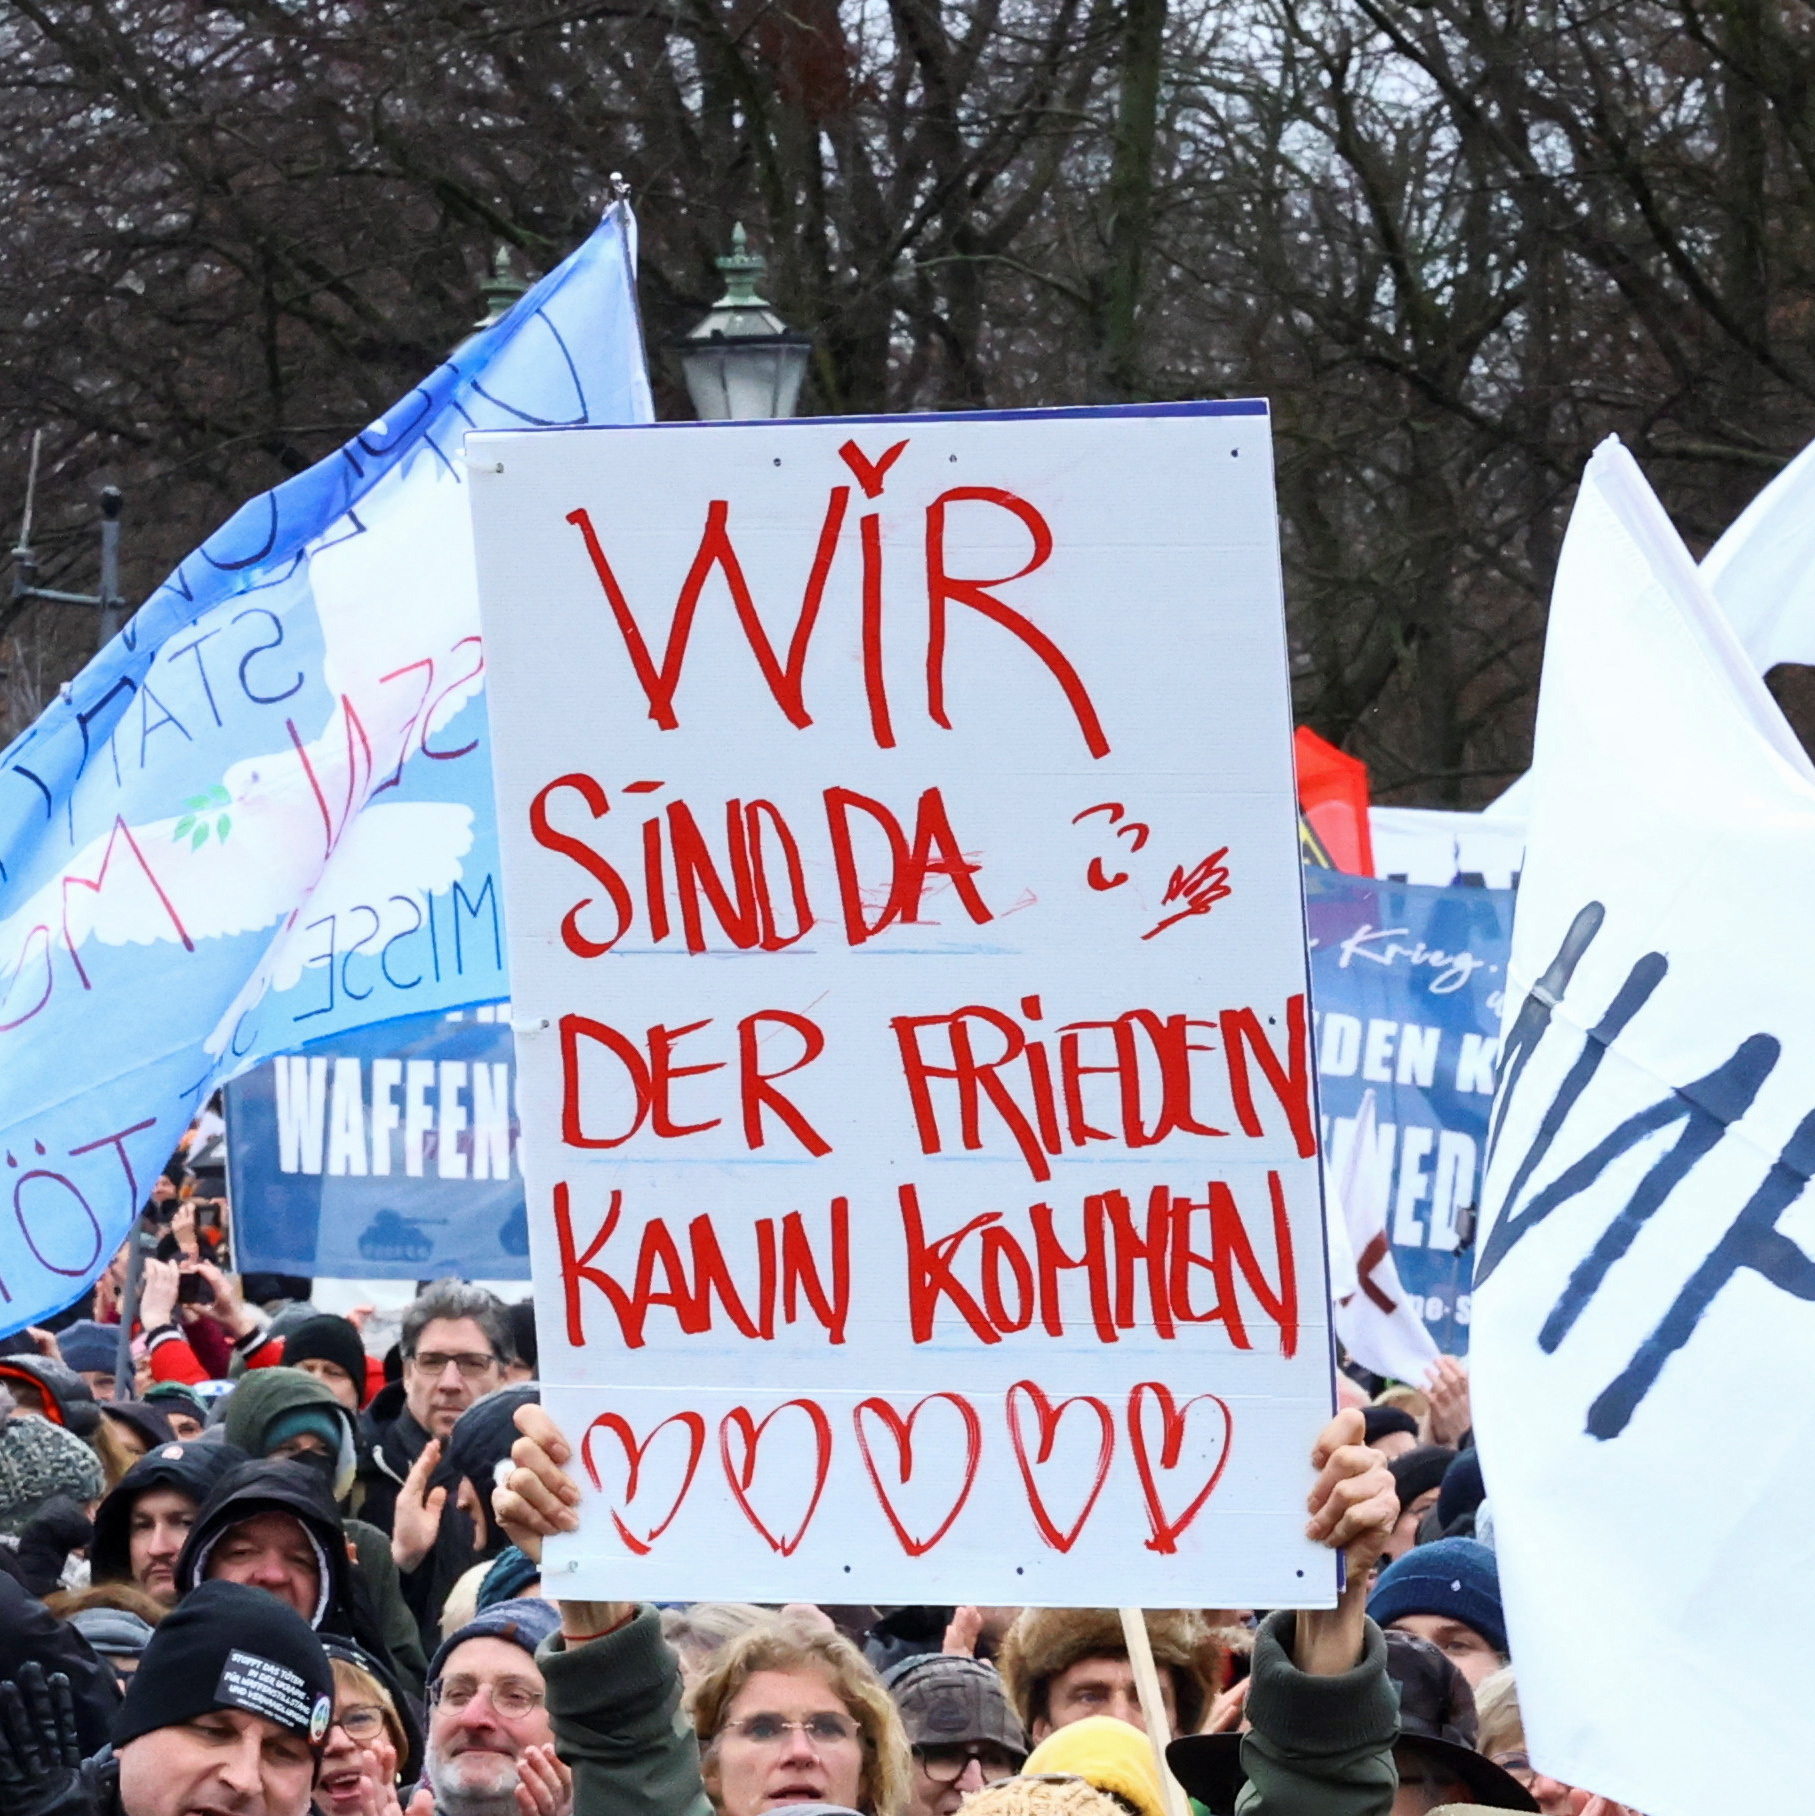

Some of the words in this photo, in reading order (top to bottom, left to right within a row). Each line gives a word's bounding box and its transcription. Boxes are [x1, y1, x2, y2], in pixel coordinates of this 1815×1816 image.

[567, 439, 1111, 760] WIR
[529, 773, 816, 959] SIND
[823, 785, 995, 947] DA
[1339, 924, 1499, 994] Krieg.
[273, 1056, 524, 1182] WAFFEN
[558, 1008, 833, 1158] DER
[888, 994, 1317, 1182] FRIEDEN
[1315, 1012, 1441, 1088] DEN
[552, 1181, 850, 1348] KANN
[897, 1169, 1301, 1360] KOMMEN
